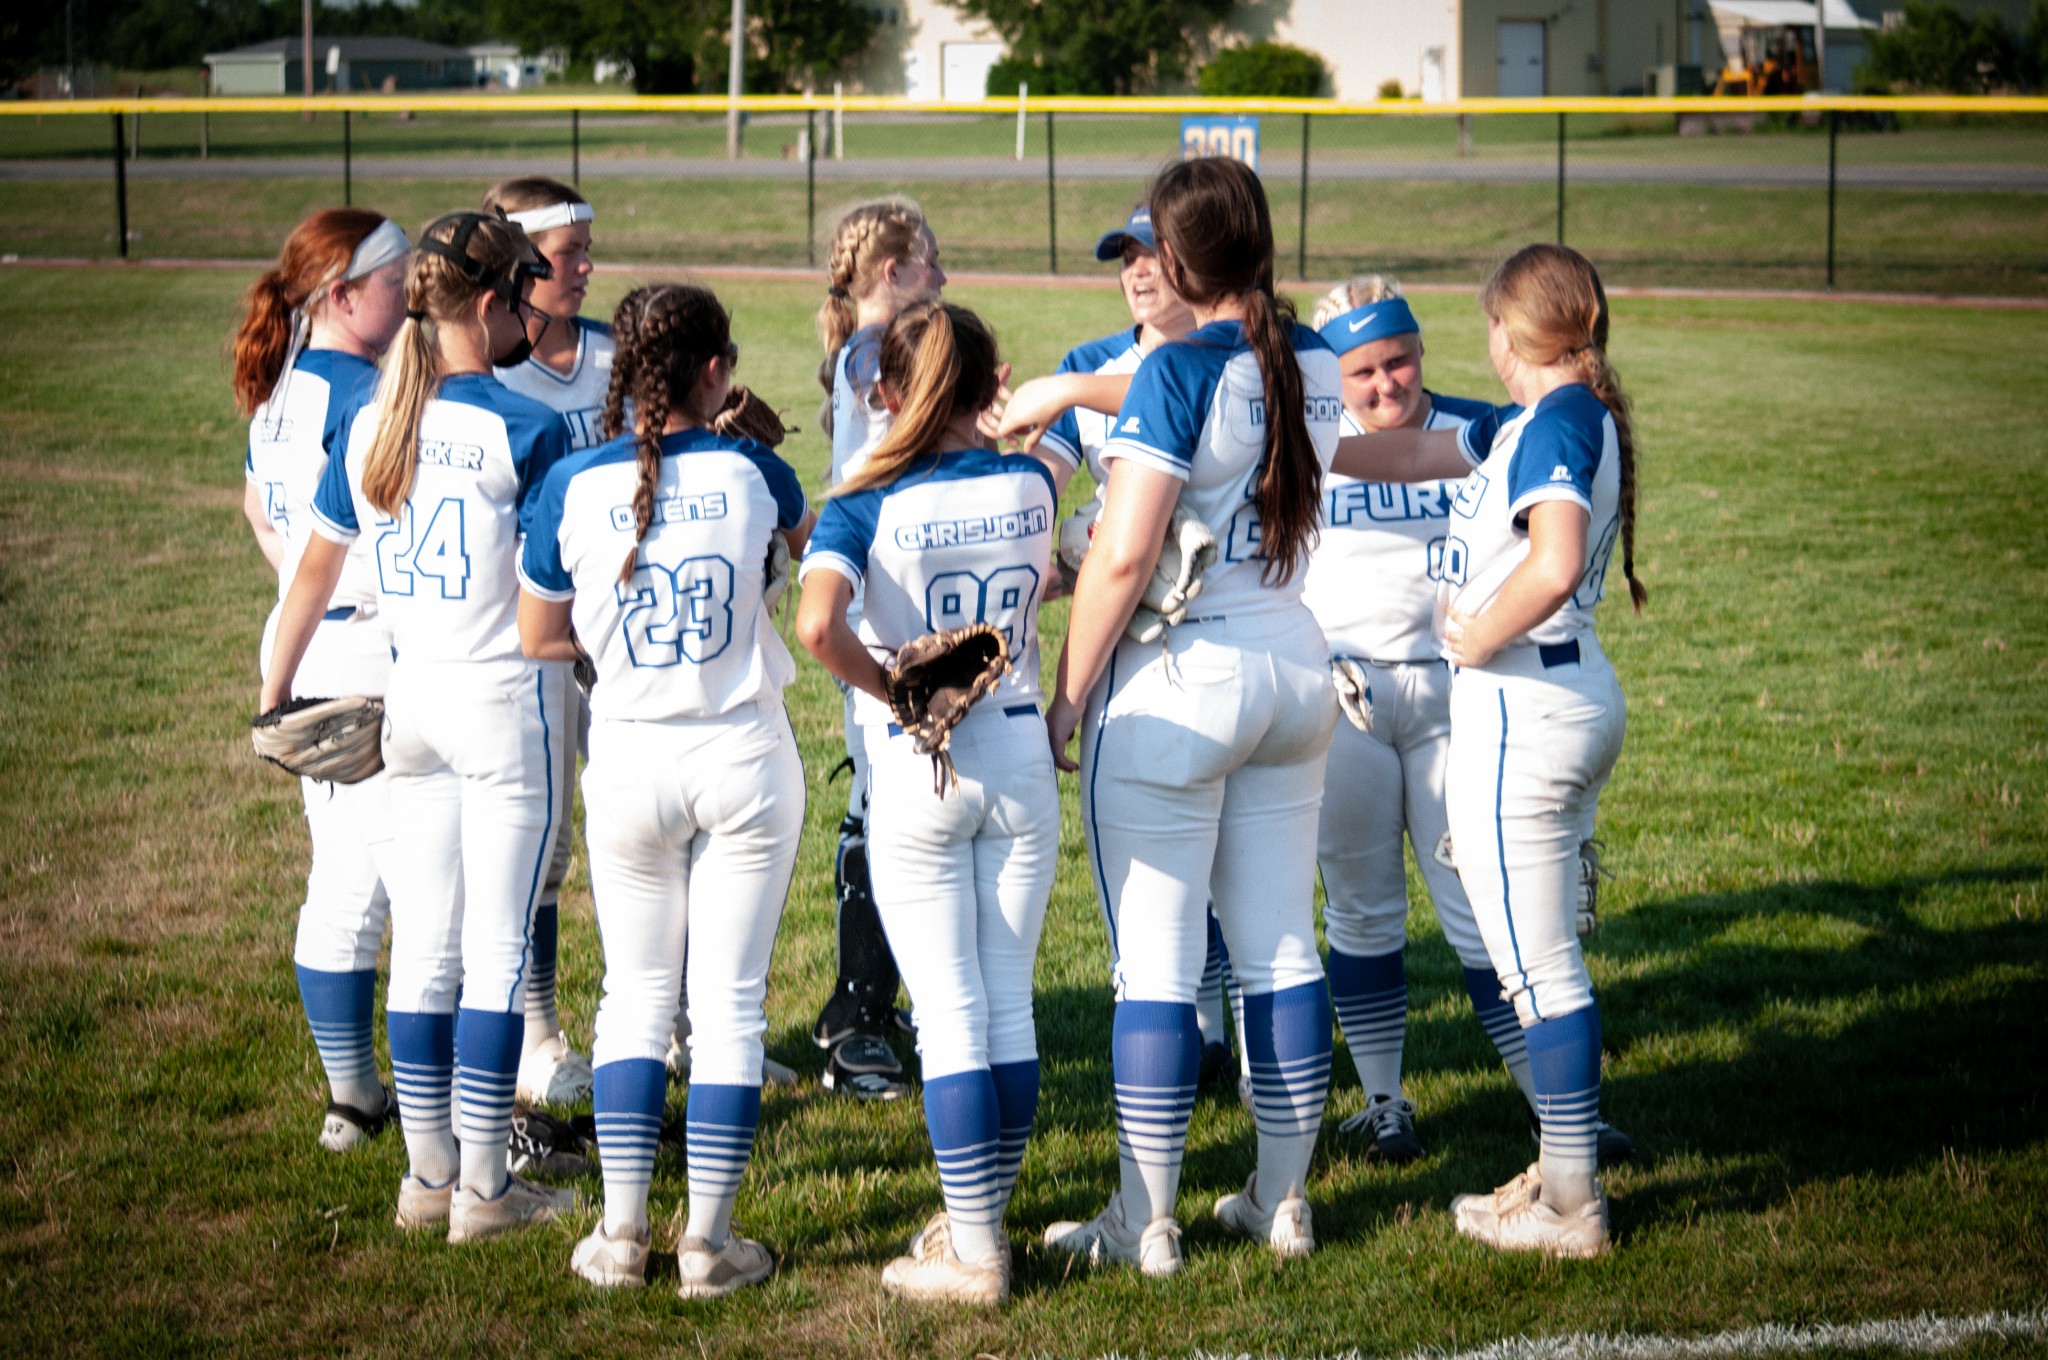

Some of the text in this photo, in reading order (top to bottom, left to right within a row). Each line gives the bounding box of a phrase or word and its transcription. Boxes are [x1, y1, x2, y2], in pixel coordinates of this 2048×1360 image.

[374, 497, 470, 600] 24
[894, 505, 1048, 552] CHRISJOHN
[615, 554, 735, 668] 23
